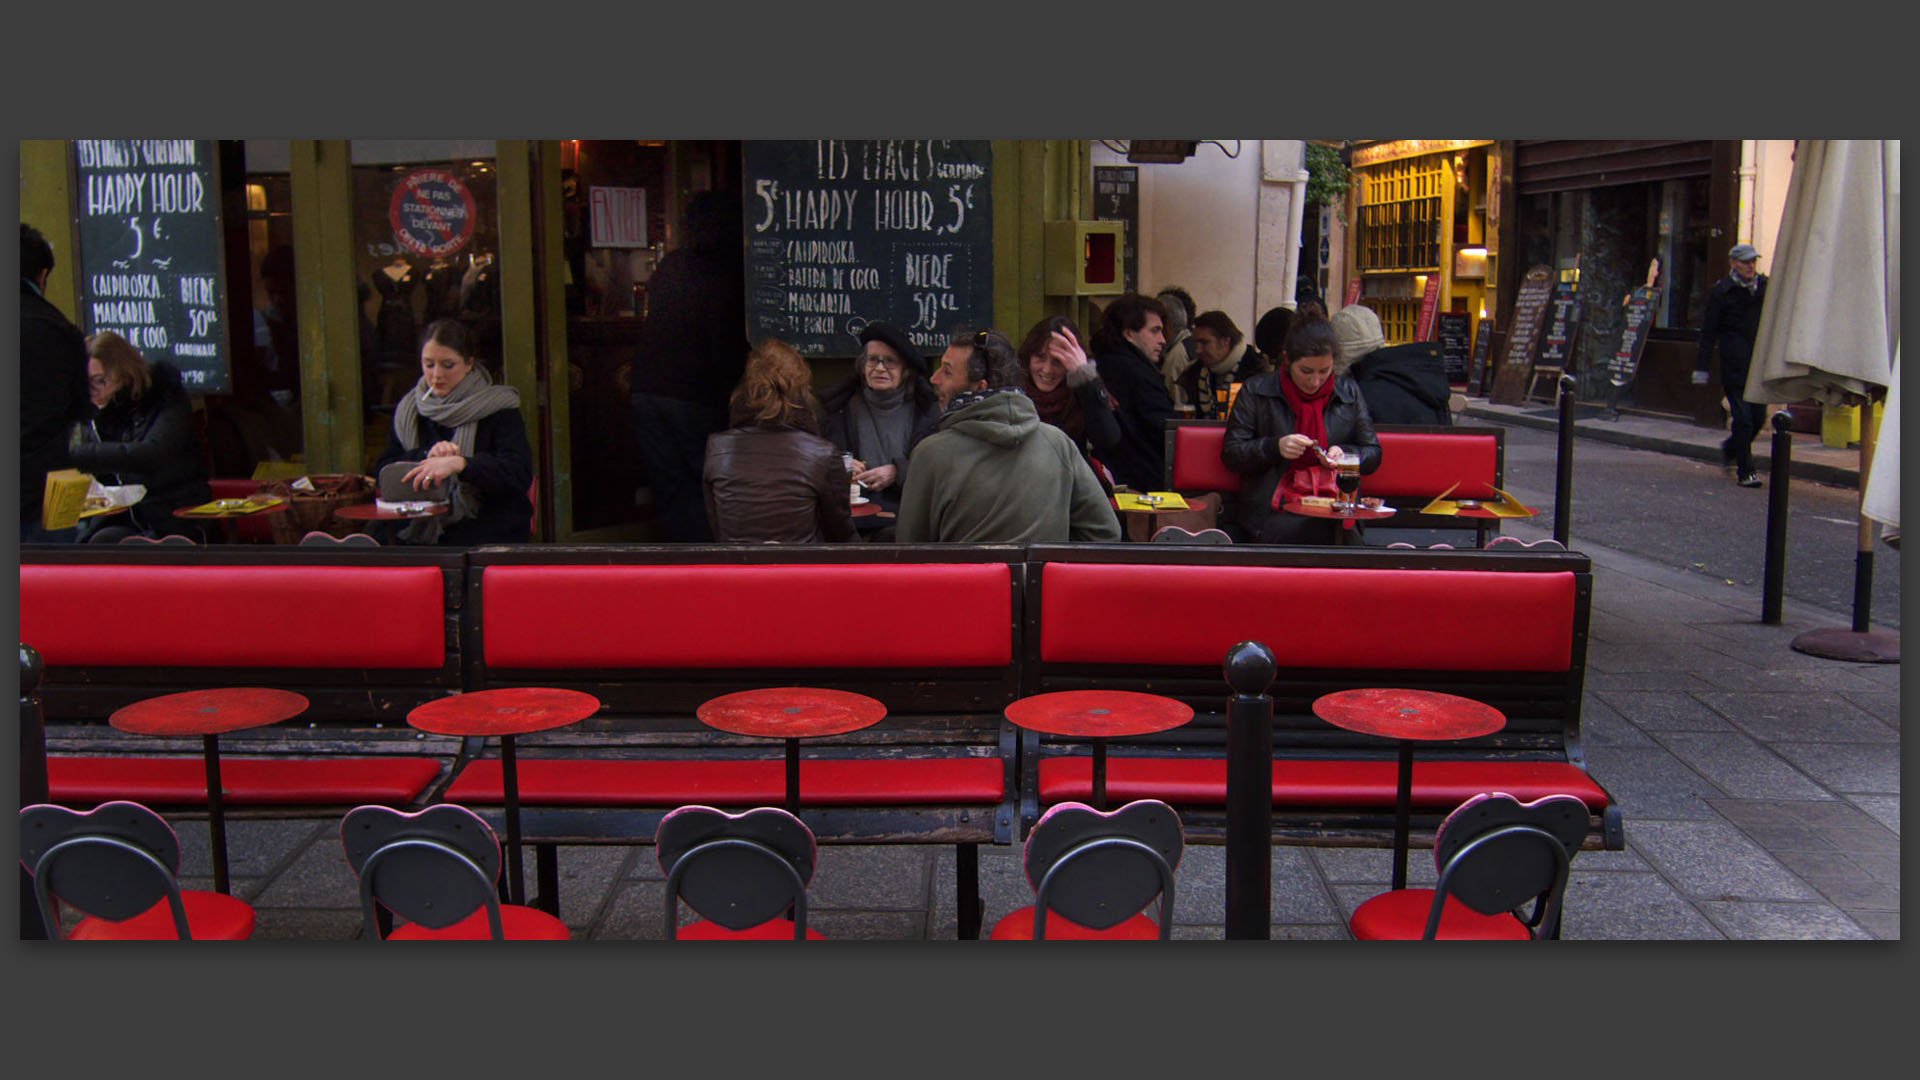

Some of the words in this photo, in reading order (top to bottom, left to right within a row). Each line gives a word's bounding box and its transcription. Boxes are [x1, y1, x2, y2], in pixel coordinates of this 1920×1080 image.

[88, 171, 146, 216] HAPPY
[151, 171, 204, 214] HOUR
[417, 189, 432, 200] NE
[433, 190, 454, 202] PAS
[403, 202, 465, 219] STATIONNER
[785, 189, 859, 231] HAPPY
[411, 217, 454, 232] DEVANT
[833, 268, 846, 290] DE
[905, 252, 955, 289] BIERE
[180, 277, 216, 307] BIERE
